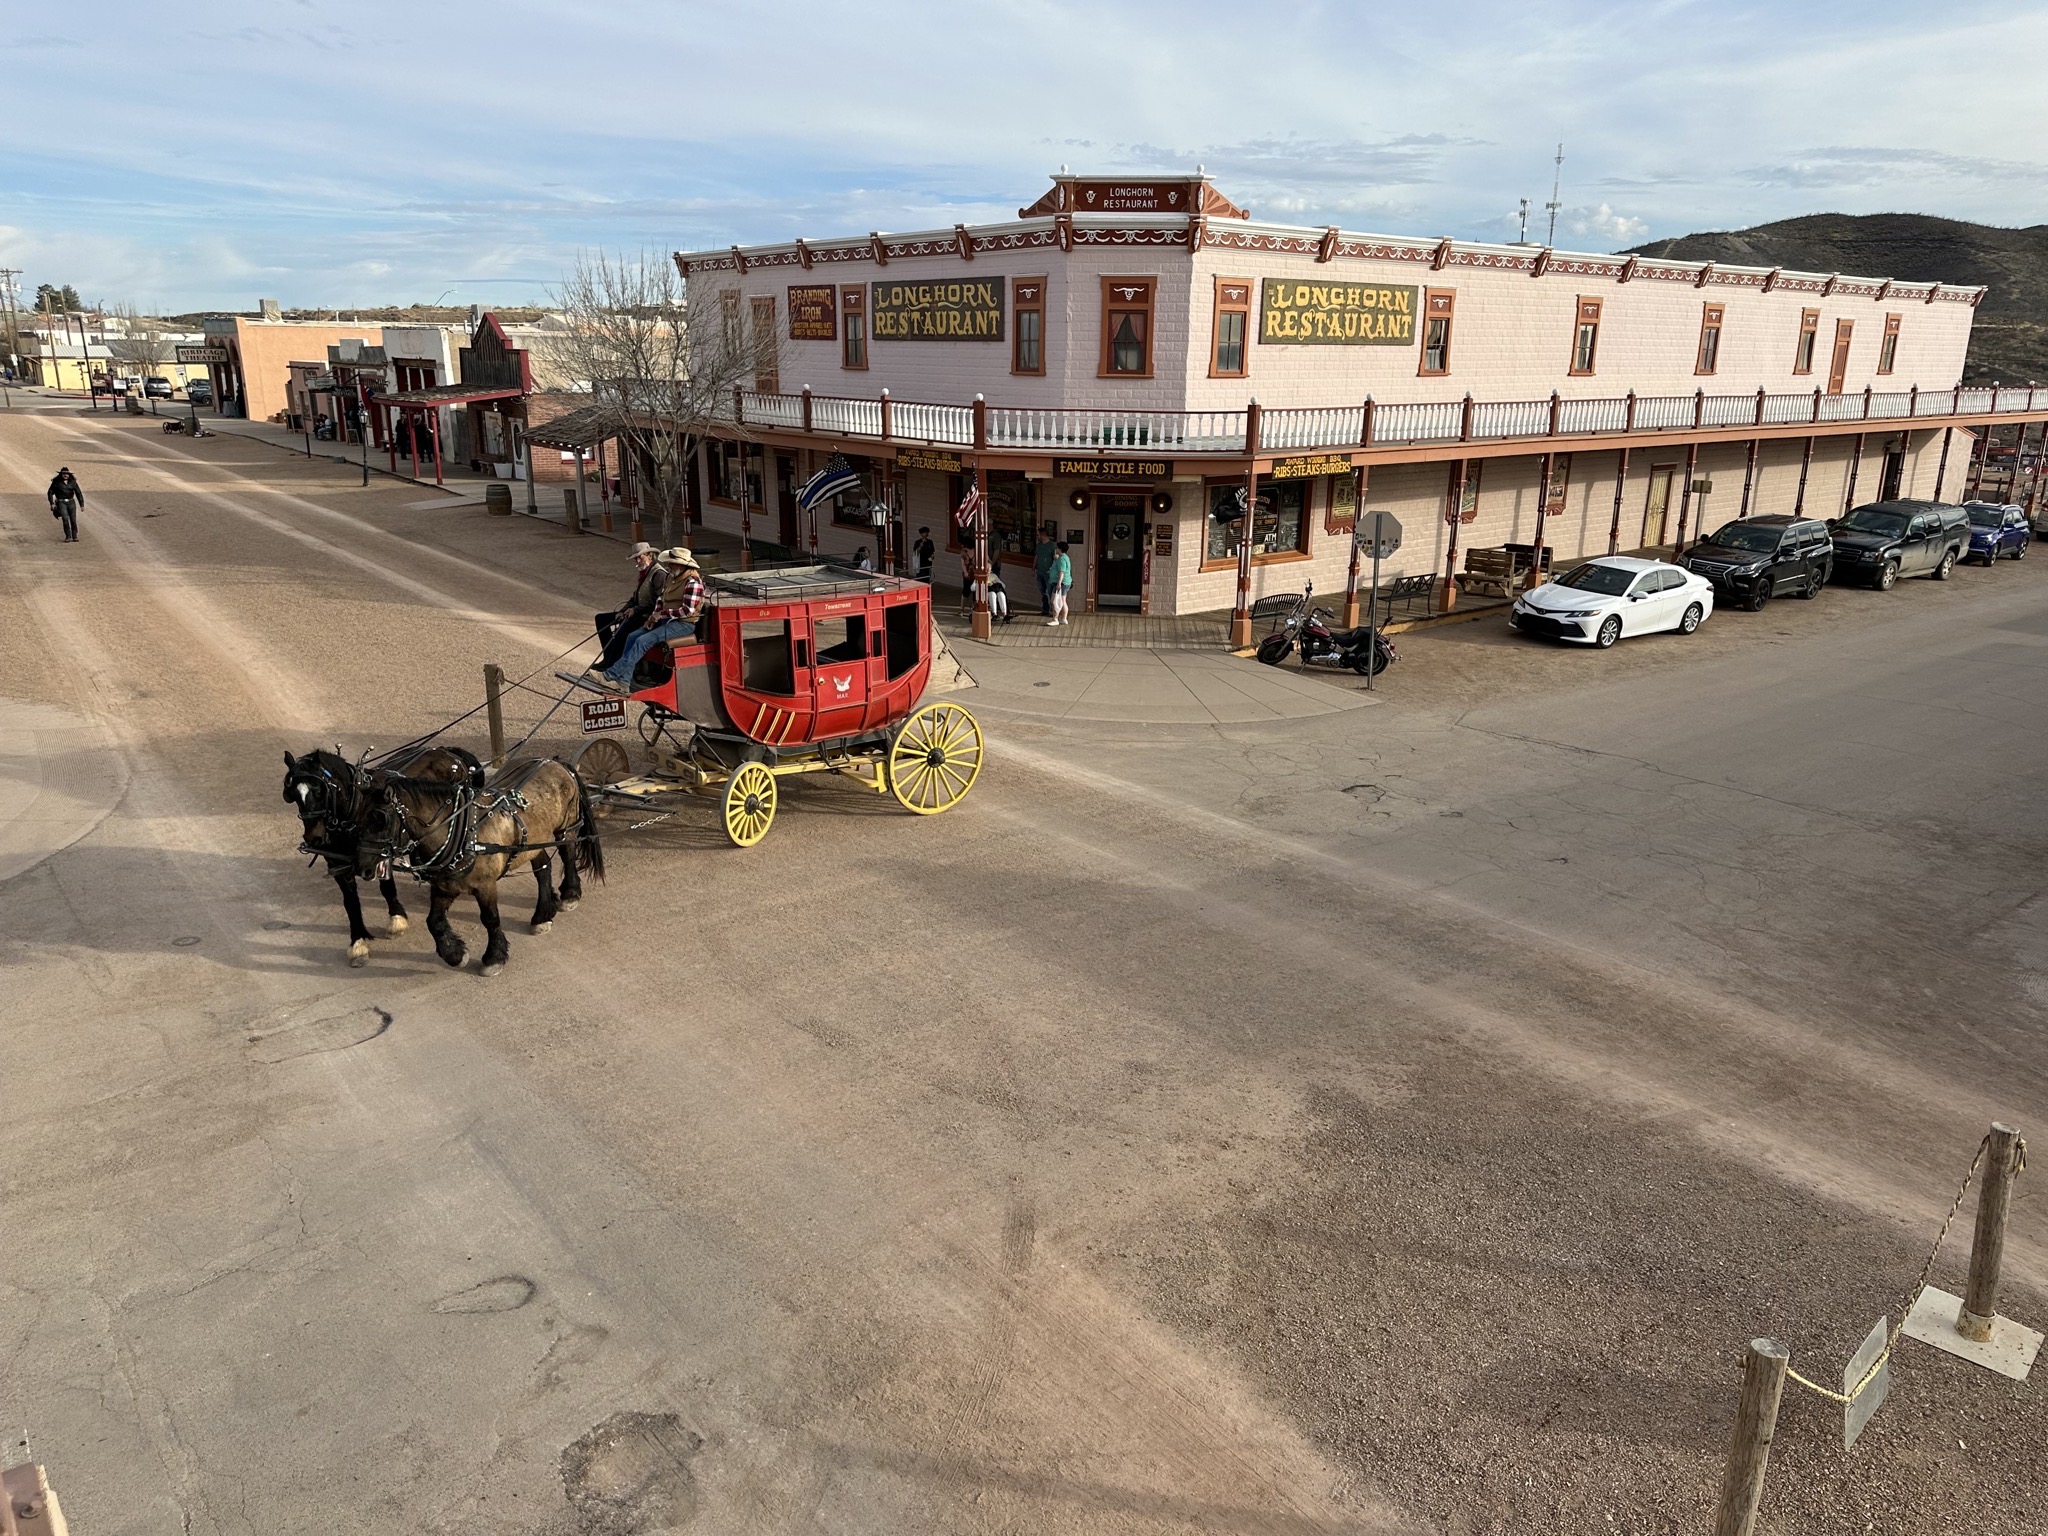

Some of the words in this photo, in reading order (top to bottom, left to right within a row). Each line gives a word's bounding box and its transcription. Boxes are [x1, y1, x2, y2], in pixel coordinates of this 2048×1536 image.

[1109, 187, 1154, 197] LONGHORN
[1103, 199, 1159, 209] RESTAURANT
[789, 288, 834, 311] BRANDING
[875, 283, 998, 309] LONGHORN
[1271, 284, 1410, 313] LONGHORN
[801, 306, 822, 321] IRON
[874, 309, 1000, 336] RESTAURANT
[1266, 310, 1412, 340] RESTAURANT
[1060, 461, 1099, 473] FAMILY
[1102, 462, 1135, 474] STYLE
[1138, 463, 1166, 475] FOOD
[1007, 533, 1020, 541] ATM
[1264, 533, 1277, 542] ATM
[588, 703, 619, 715] ROAD
[585, 716, 624, 729] CLOSED
